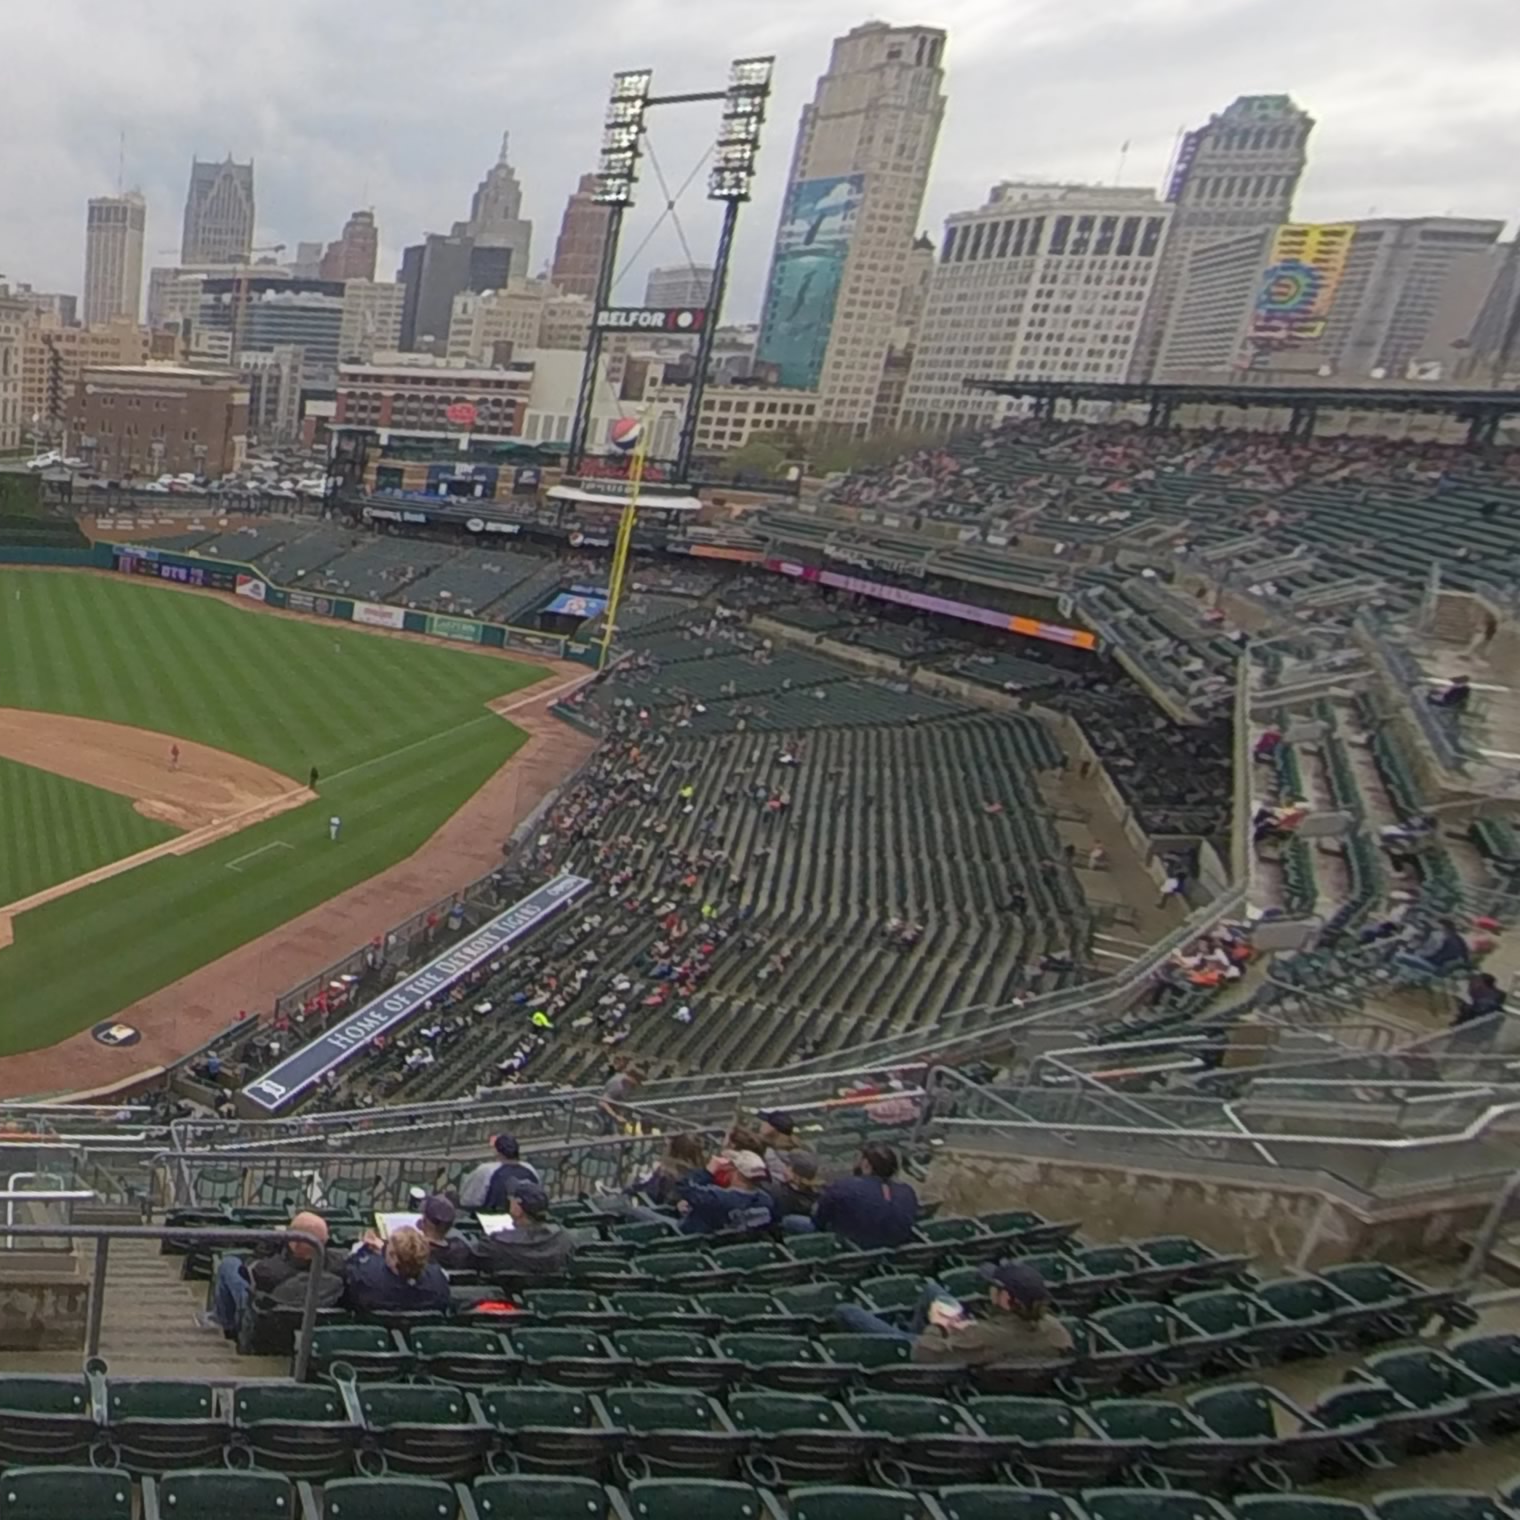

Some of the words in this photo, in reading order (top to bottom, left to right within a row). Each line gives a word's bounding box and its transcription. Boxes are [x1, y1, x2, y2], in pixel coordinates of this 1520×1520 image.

[596, 310, 666, 327] BELFOR
[327, 1010, 389, 1050] HOME
[384, 992, 410, 1013] OF
[405, 973, 443, 996] THE
[435, 930, 501, 975] DETROIT
[491, 904, 542, 934] TIGERS
